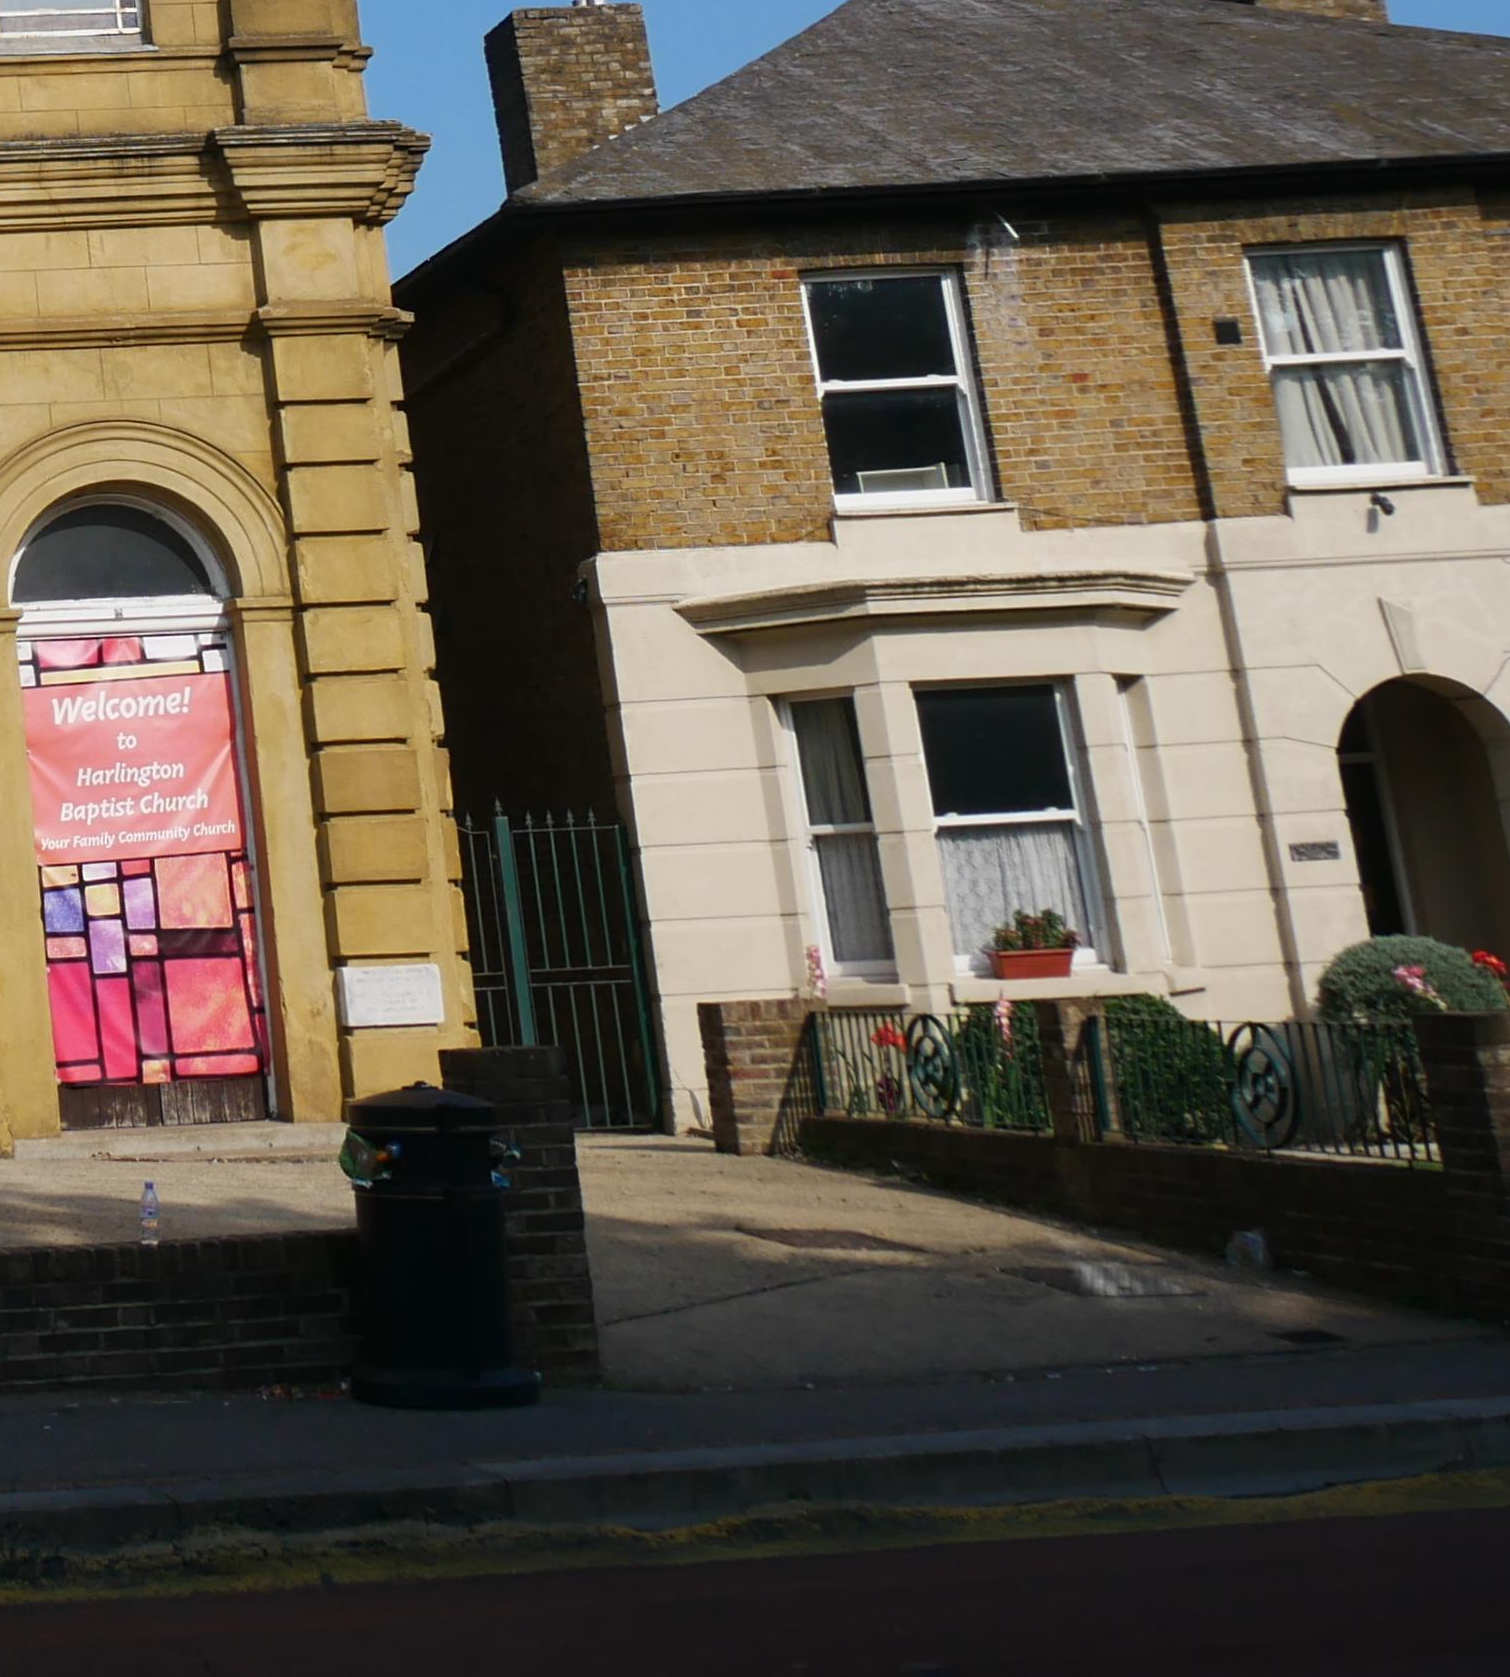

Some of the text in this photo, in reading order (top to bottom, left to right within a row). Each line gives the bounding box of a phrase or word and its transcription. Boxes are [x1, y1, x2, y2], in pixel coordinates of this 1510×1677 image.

[52, 687, 191, 725] Welcome!
[117, 732, 137, 750] to
[76, 761, 185, 787] Harlington
[60, 788, 208, 825] Baptist Church
[40, 820, 235, 851] Your Family Community Church
